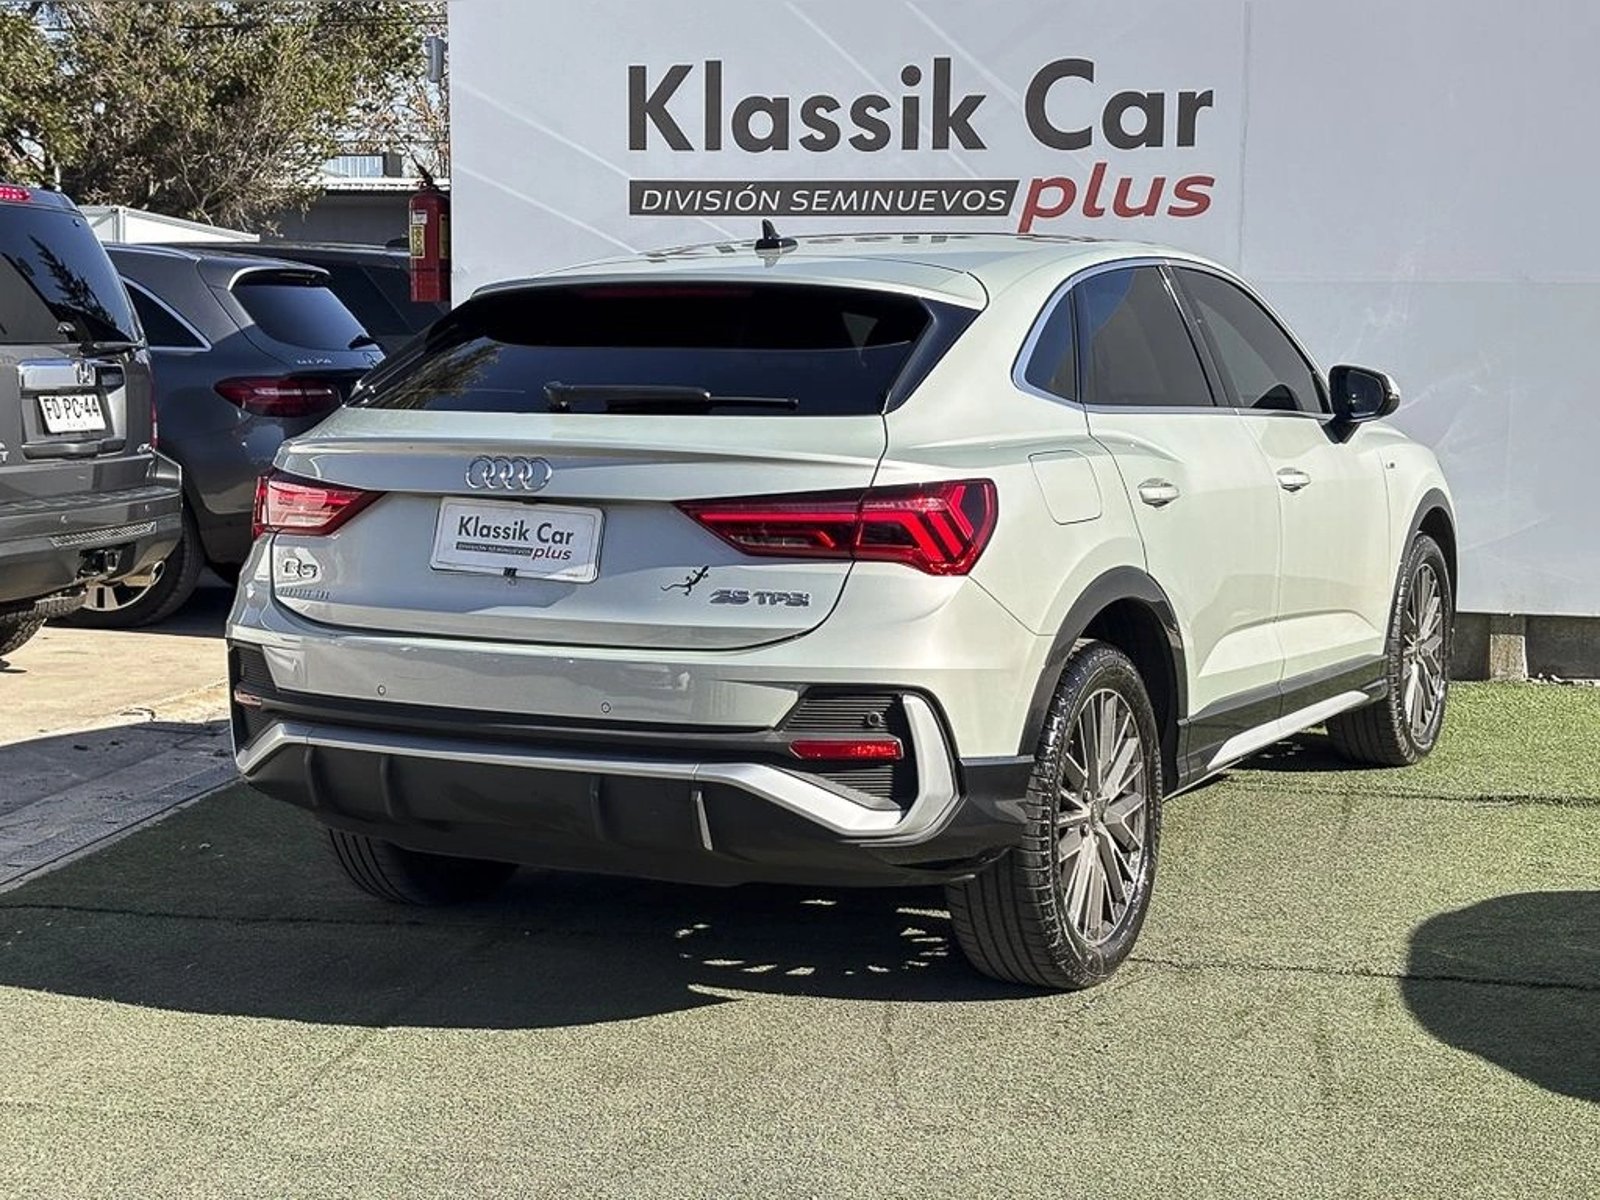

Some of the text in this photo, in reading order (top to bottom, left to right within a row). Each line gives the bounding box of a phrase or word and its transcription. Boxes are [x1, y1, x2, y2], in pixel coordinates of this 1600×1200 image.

[628, 57, 1214, 153] Klassik Car
[641, 183, 1007, 211] DIVISIÓN SEMINUEVOS
[1018, 162, 1215, 234] plus
[457, 515, 574, 545] Klassik Car
[532, 546, 573, 560] plus
